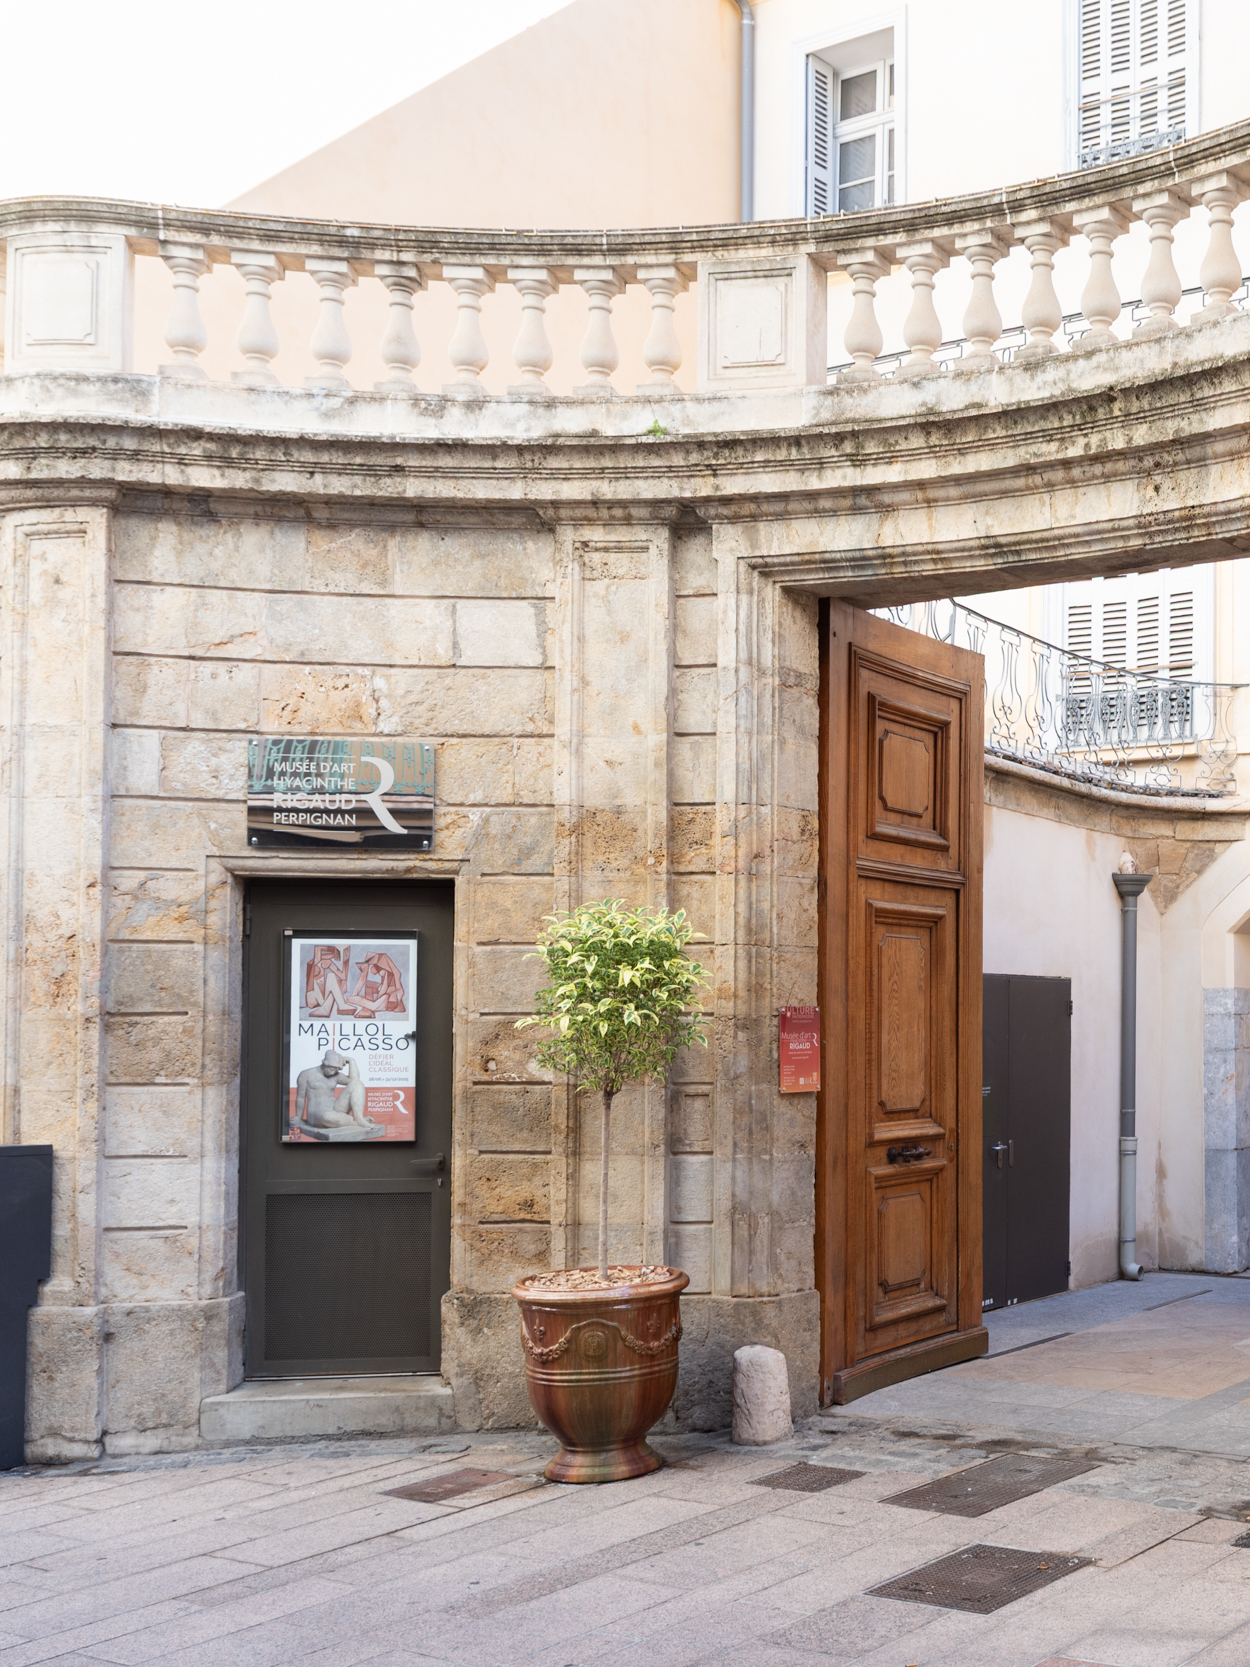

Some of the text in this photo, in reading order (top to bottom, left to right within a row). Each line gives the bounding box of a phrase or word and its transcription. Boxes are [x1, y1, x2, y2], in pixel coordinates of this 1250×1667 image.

[273, 759, 356, 774] MUSÉE D'ART
[273, 776, 356, 790] HYACINTHE
[273, 792, 356, 810] RIGAUD
[360, 756, 408, 834] R
[273, 812, 356, 826] PERPIGNAN
[298, 1023, 393, 1037] MAILLOL
[781, 1031, 799, 1039] Musée
[317, 1037, 410, 1051] PICASSO
[789, 1042, 811, 1050] RIGAUD
[393, 1089, 409, 1114] R
